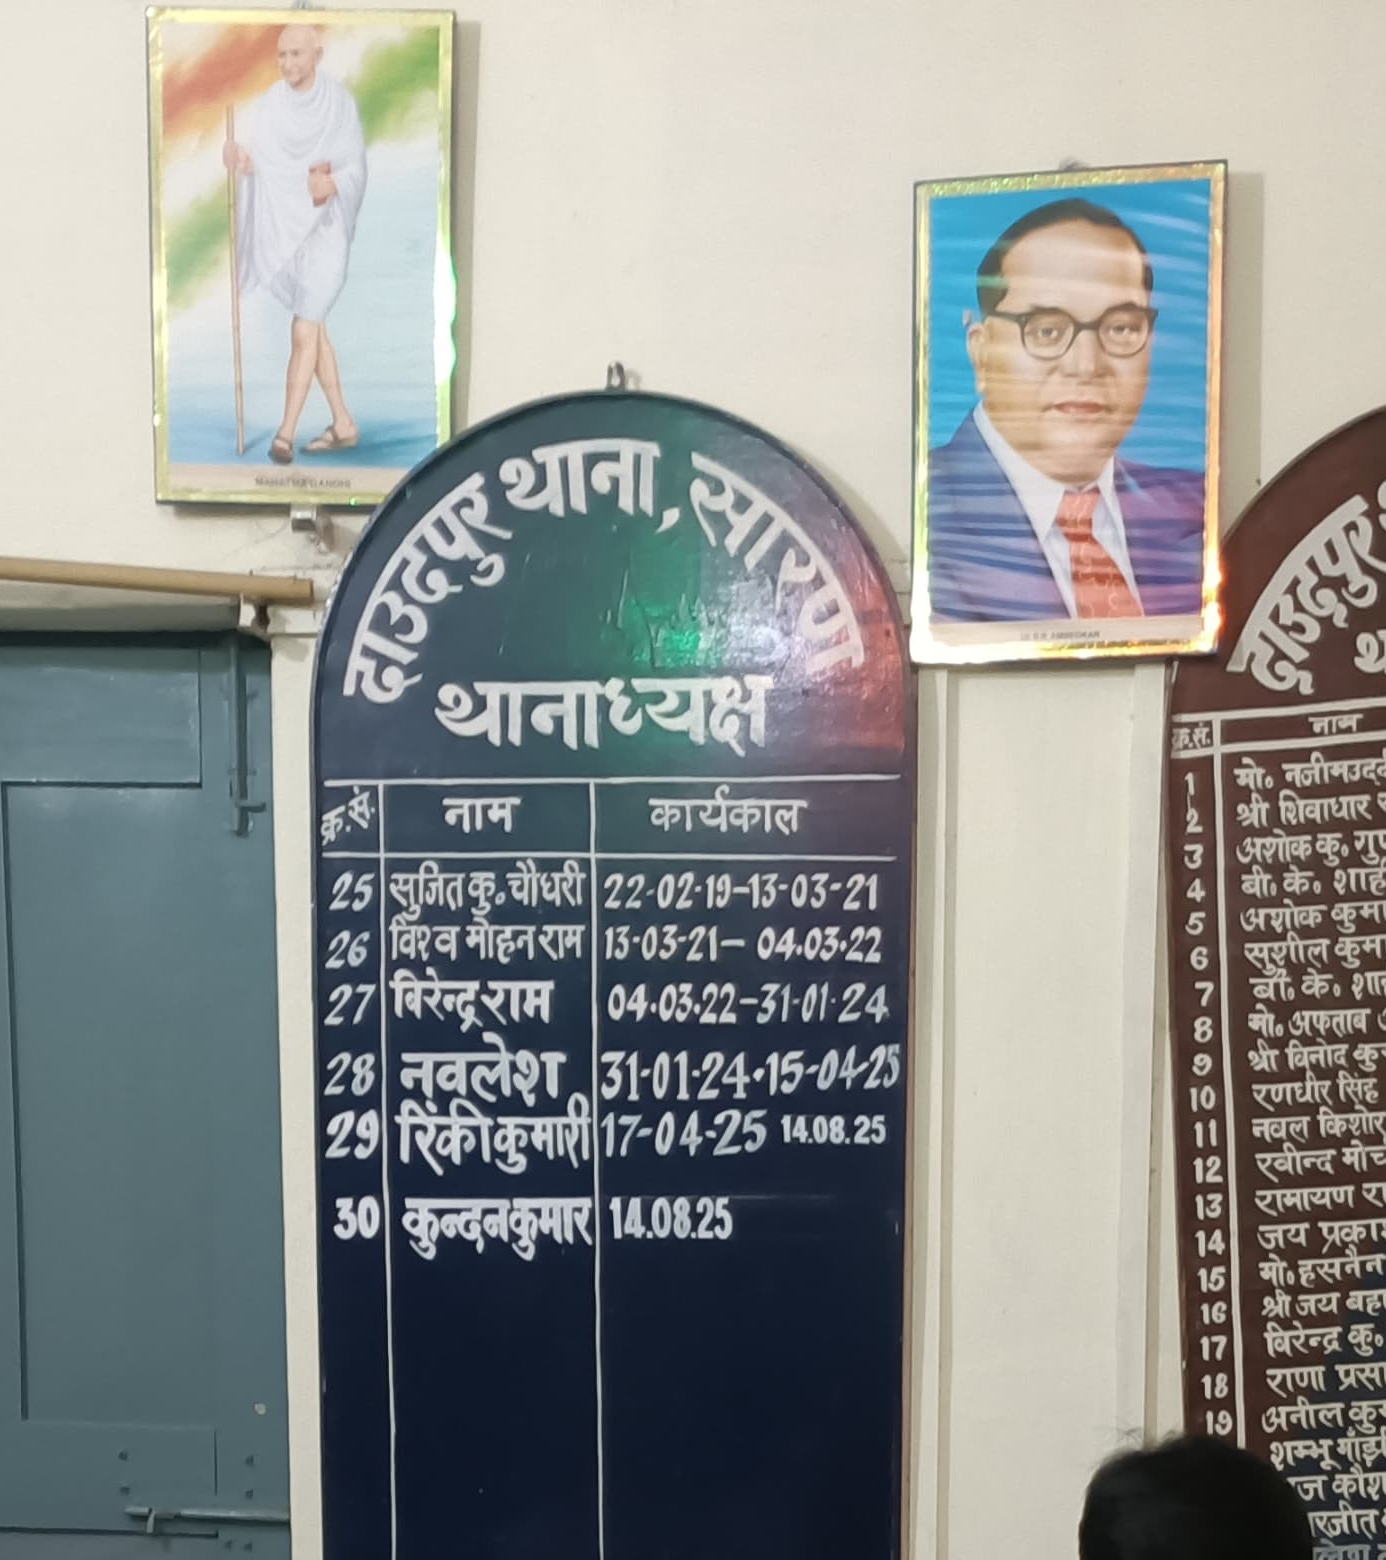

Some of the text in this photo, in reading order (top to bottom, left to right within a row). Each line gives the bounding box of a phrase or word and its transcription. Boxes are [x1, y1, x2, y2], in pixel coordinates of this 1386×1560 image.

[343, 472, 513, 704] दाउदपुर
[690, 451, 864, 676] सारण
[434, 675, 773, 757] थानाध्यक्ष
[1309, 714, 1363, 736] नाम
[1185, 772, 1195, 795] 1
[444, 797, 521, 833] नाम
[649, 785, 808, 836] कार्यकाल
[1186, 808, 1203, 834] 2
[1237, 793, 1270, 827] श्री
[1184, 844, 1203, 868] 3
[1237, 829, 1312, 863] अशोक
[329, 872, 374, 911] 25
[389, 861, 465, 914] सुजित
[1187, 879, 1205, 902] 4
[1185, 912, 1205, 935] 5
[1240, 898, 1327, 932] अशोक
[325, 930, 371, 968] 26
[538, 924, 584, 959] राम
[1190, 947, 1208, 970] 6
[1245, 931, 1330, 976] सुशील
[324, 985, 376, 1025] 27
[487, 980, 554, 1025] राम
[1195, 982, 1214, 1006] 7
[1194, 1017, 1213, 1042] 8
[324, 1051, 375, 1095] 28
[399, 1032, 566, 1106] नवलेश
[1192, 1053, 1212, 1076] 9
[1248, 1039, 1278, 1072] श्री
[1190, 1070, 1379, 1111] 10 रणधीर सिंह
[325, 1110, 380, 1160] 29
[781, 1114, 887, 1145] 14.08.25
[1194, 1119, 1217, 1147] 11
[1252, 1116, 1310, 1143] नवल
[1318, 1105, 1386, 1136] किशोर
[1193, 1156, 1223, 1183] 12
[334, 1196, 380, 1240] 30
[610, 1196, 733, 1240] 14.08.25
[1195, 1193, 1223, 1220] 13
[1255, 1186, 1354, 1217] रामायण
[1195, 1230, 1225, 1257] 14
[1257, 1222, 1310, 1249] जय
[1198, 1267, 1226, 1292] 15
[1201, 1302, 1227, 1324] 16
[1262, 1289, 1291, 1318] श्री
[1296, 1293, 1340, 1317] जय
[1201, 1335, 1227, 1360] 17
[1202, 1373, 1228, 1399] 18
[1267, 1366, 1325, 1398] राणा
[1206, 1410, 1232, 1436] 19
[1262, 1396, 1344, 1433] अनील
